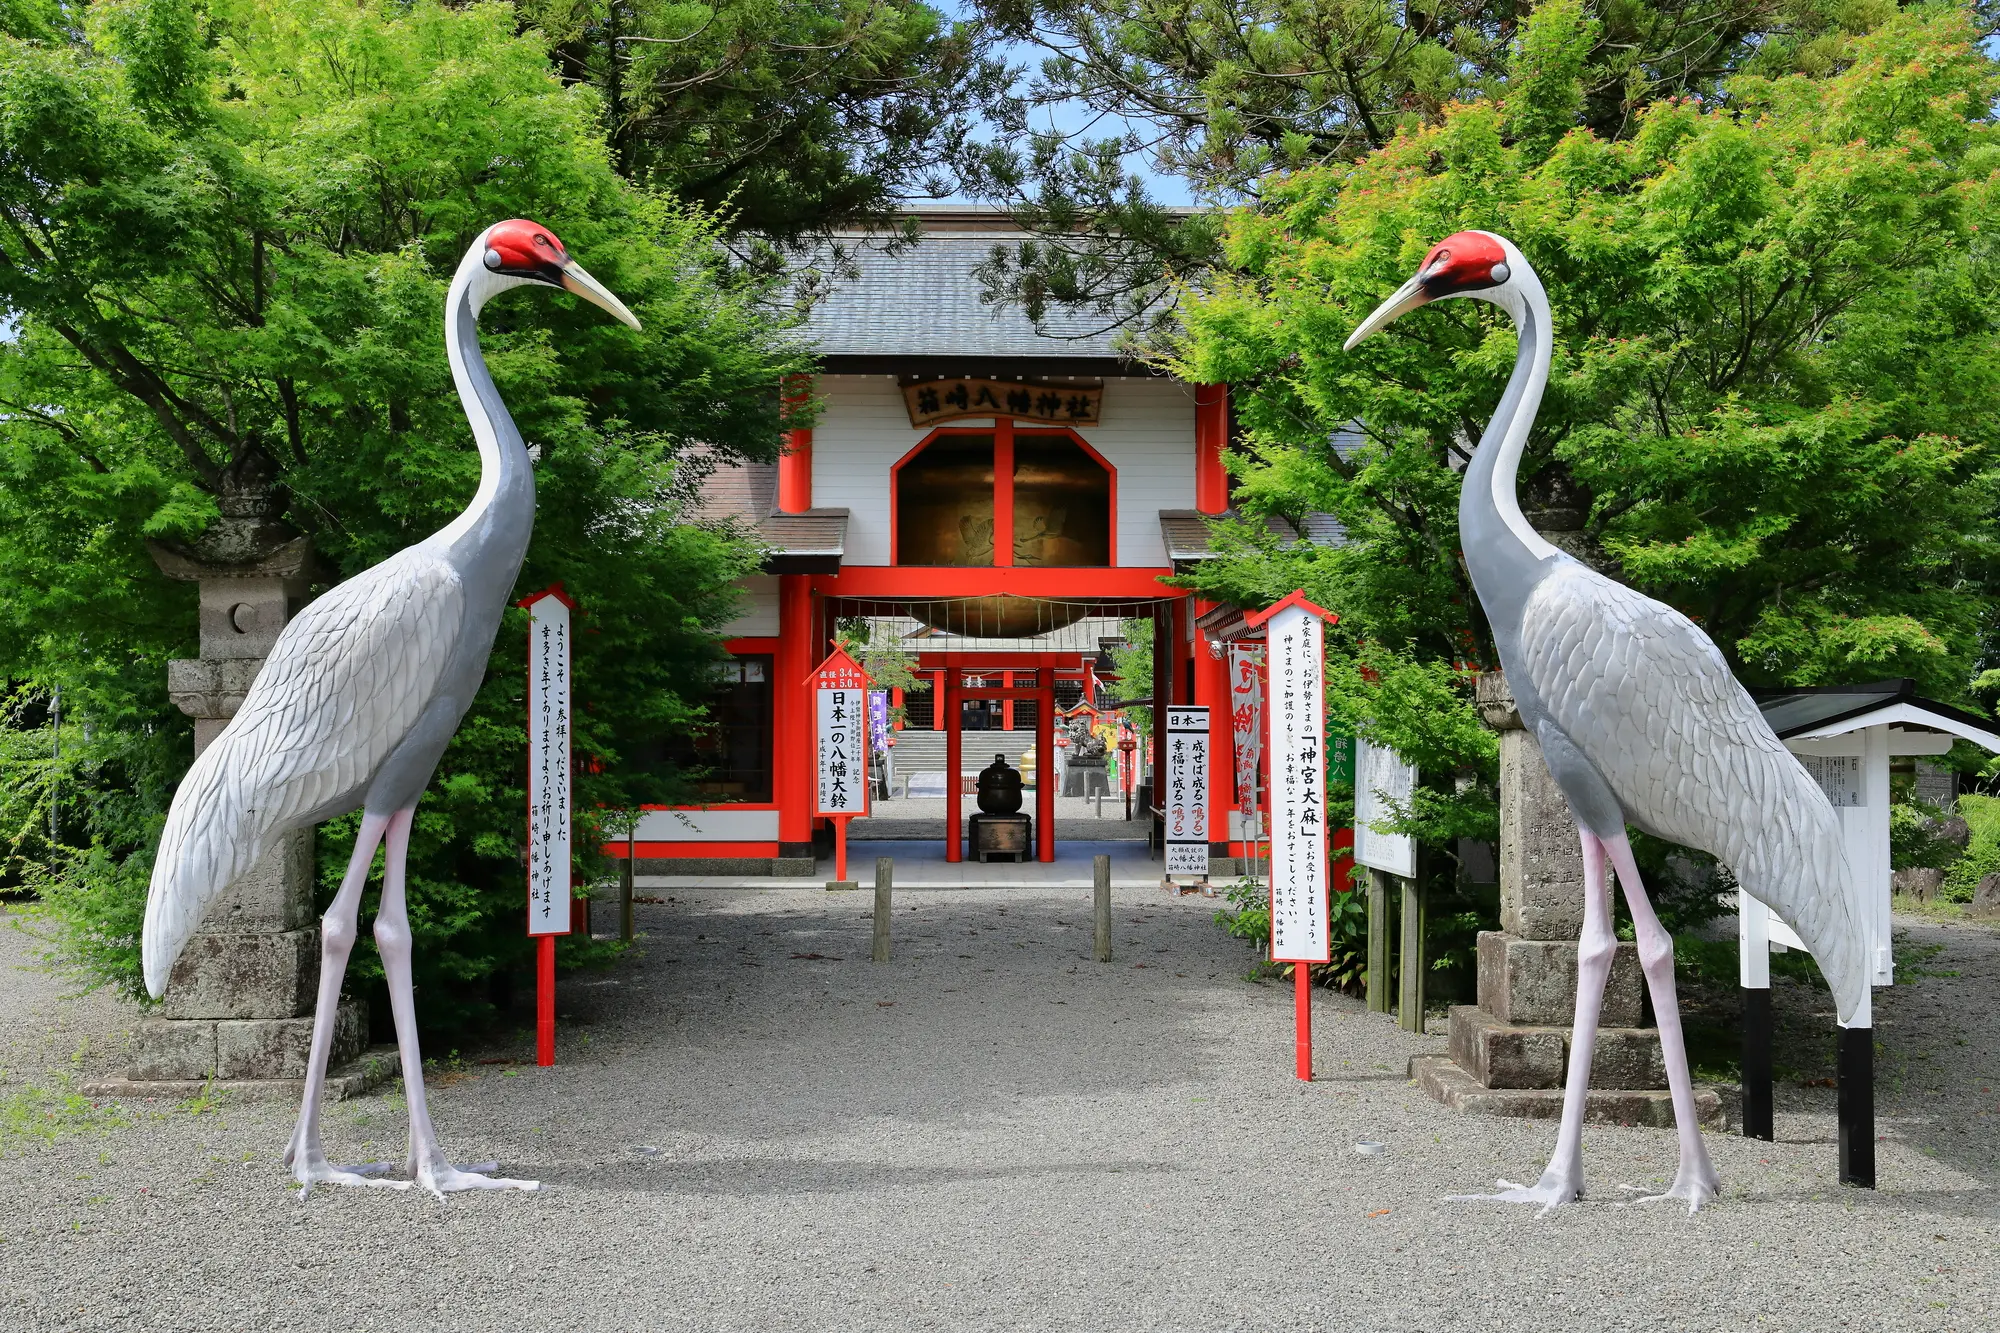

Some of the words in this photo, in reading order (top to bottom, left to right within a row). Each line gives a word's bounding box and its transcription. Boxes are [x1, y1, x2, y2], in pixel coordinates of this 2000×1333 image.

[820, 680, 837, 689] 重さ
[1170, 714, 1207, 726] 日本一
[829, 691, 848, 809] 日本一の八幡大鈴
[852, 768, 860, 784] 記念
[530, 805, 540, 901] 箱崎八幡神社
[1170, 854, 1206, 863] 八幡大鈴
[1275, 888, 1284, 946] 箱崎八幡神社
